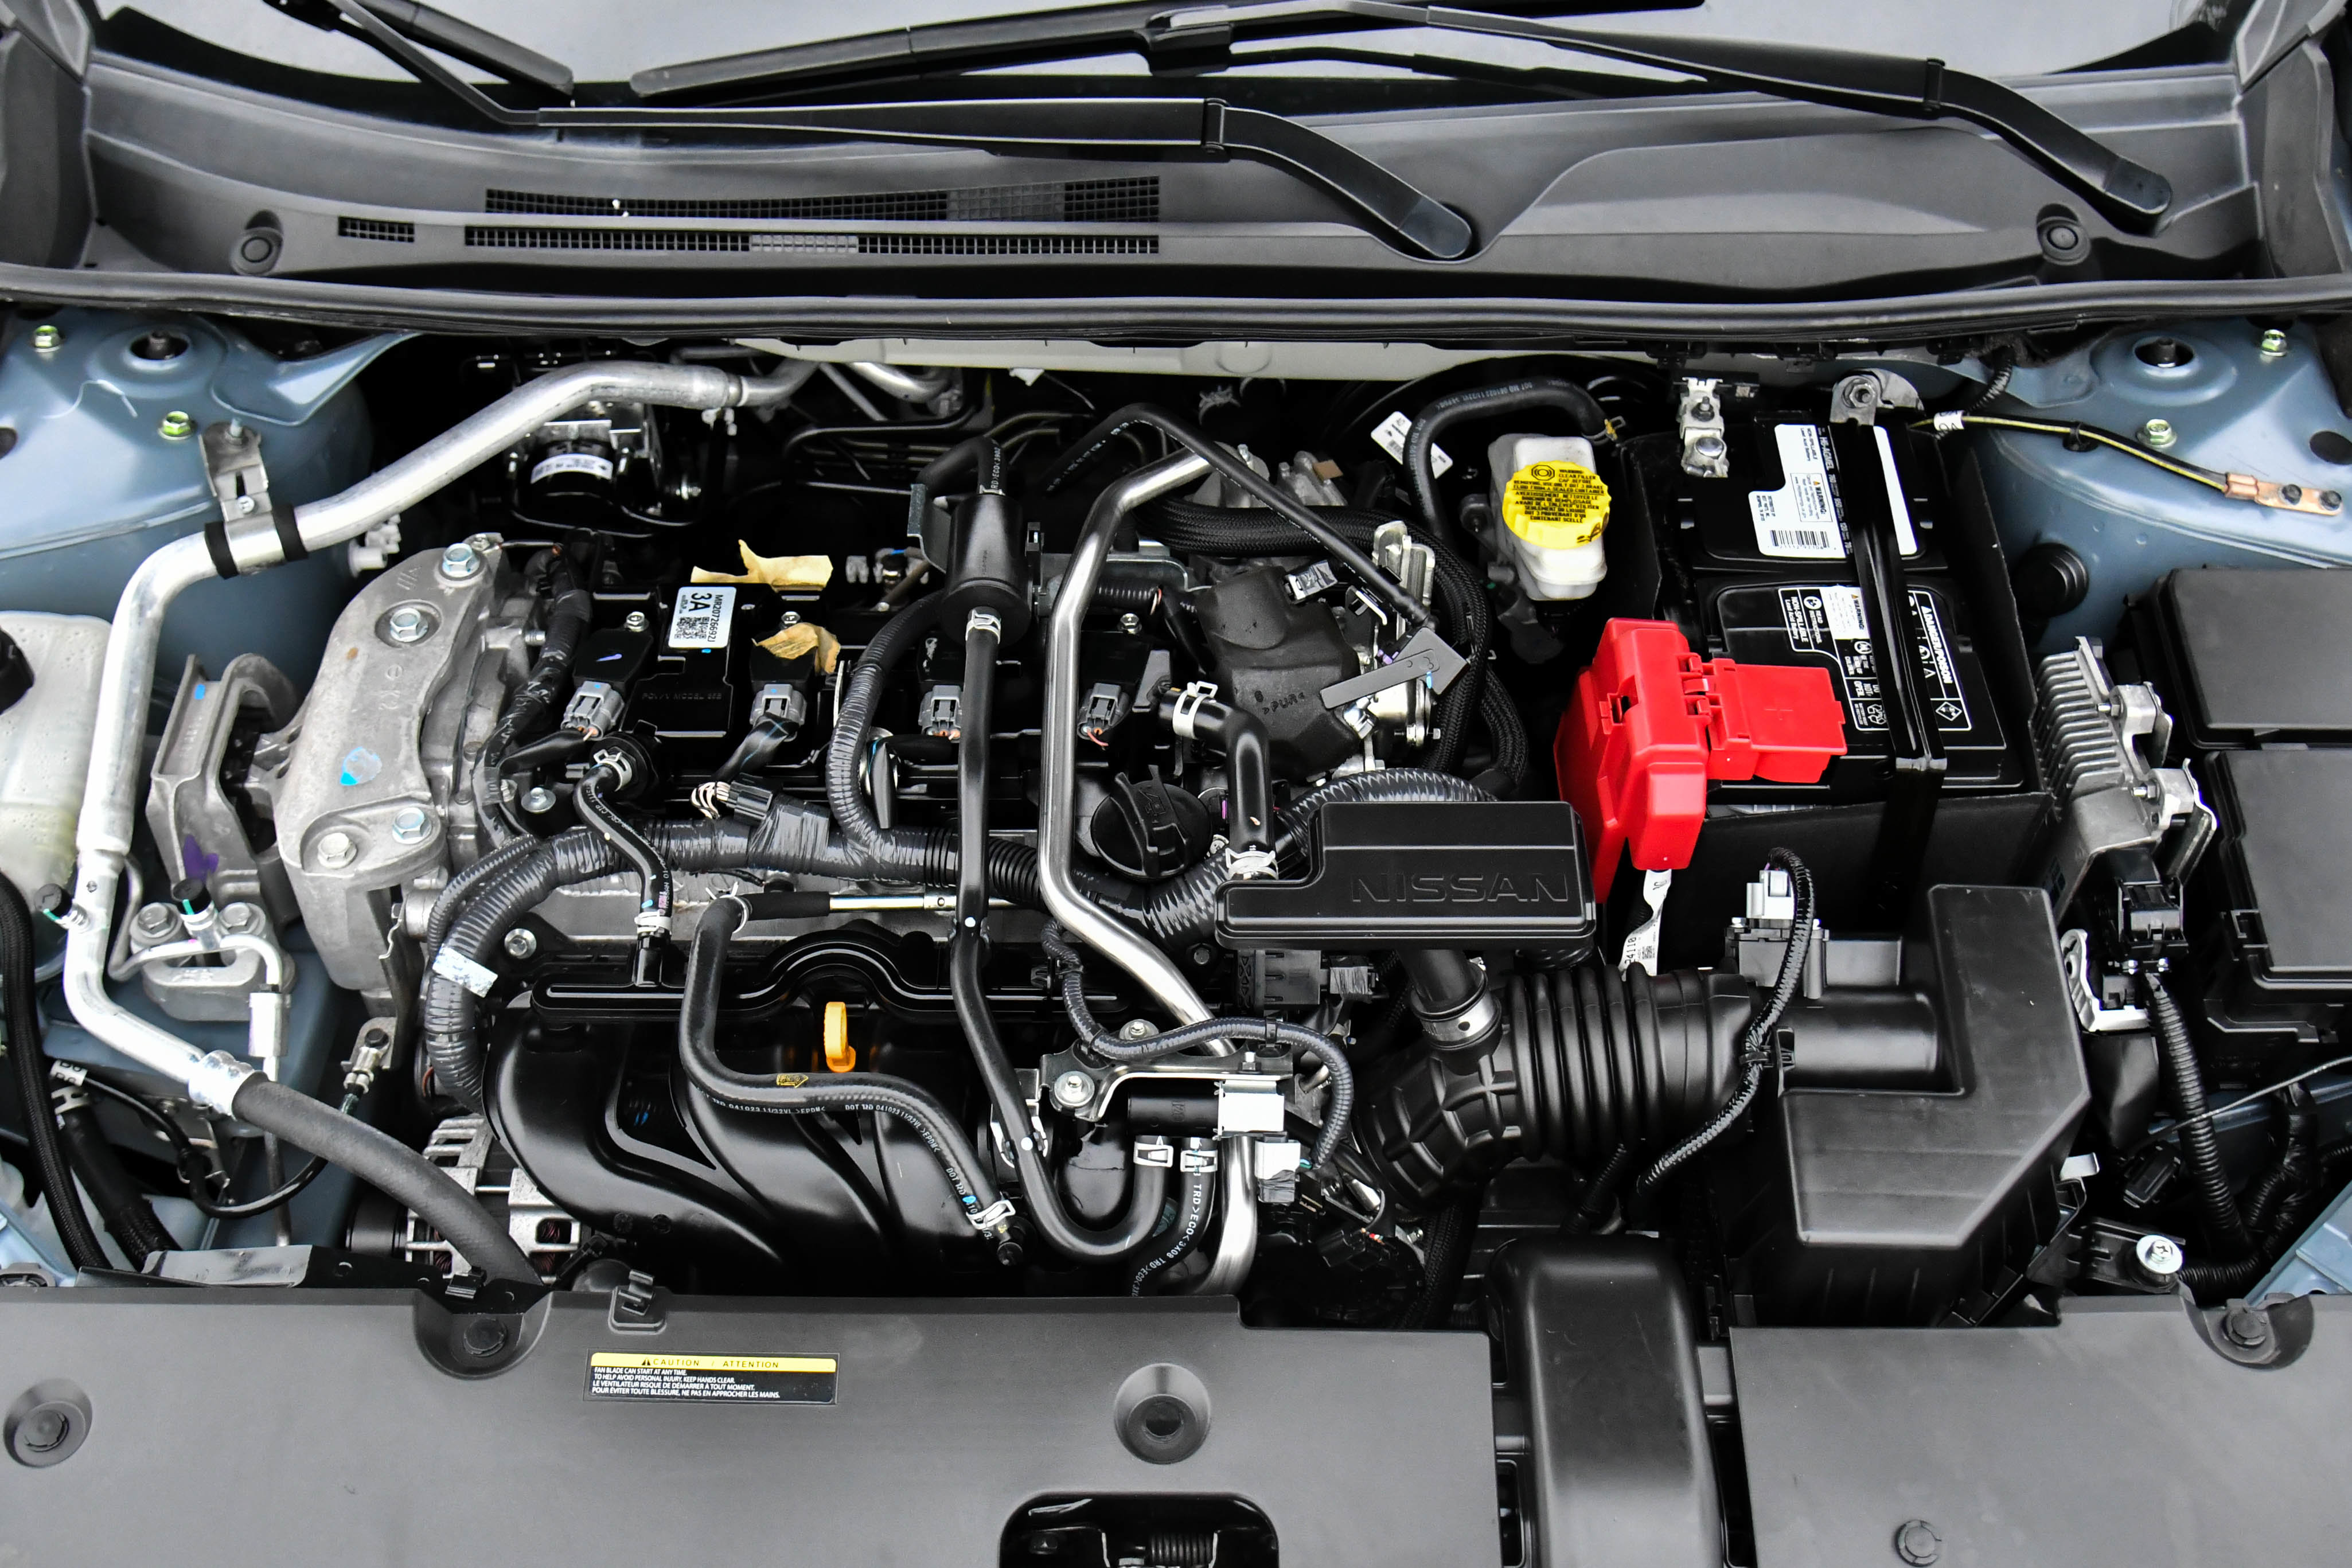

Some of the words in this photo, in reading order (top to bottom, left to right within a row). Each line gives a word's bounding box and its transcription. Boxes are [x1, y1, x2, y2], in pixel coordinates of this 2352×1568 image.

[1815, 486, 1827, 514] WARNING:
[689, 592, 712, 611] 3A
[1791, 596, 1808, 642] NON-SPILLABLE
[1815, 610, 1823, 624] READ
[1852, 598, 1866, 630] WARNING:
[1792, 623, 1800, 640] Battery
[1923, 610, 1953, 684] DANGER/POISON
[1853, 680, 1865, 698] OPEN.
[1351, 872, 1569, 903] NISSAN
[728, 1104, 760, 1113] 041023
[876, 1105, 900, 1115] 041023
[900, 1110, 922, 1129] 11/32VL
[920, 1128, 941, 1153] >EPDM<
[946, 1167, 959, 1181] DOT
[610, 1386, 630, 1394] ÉVITER
